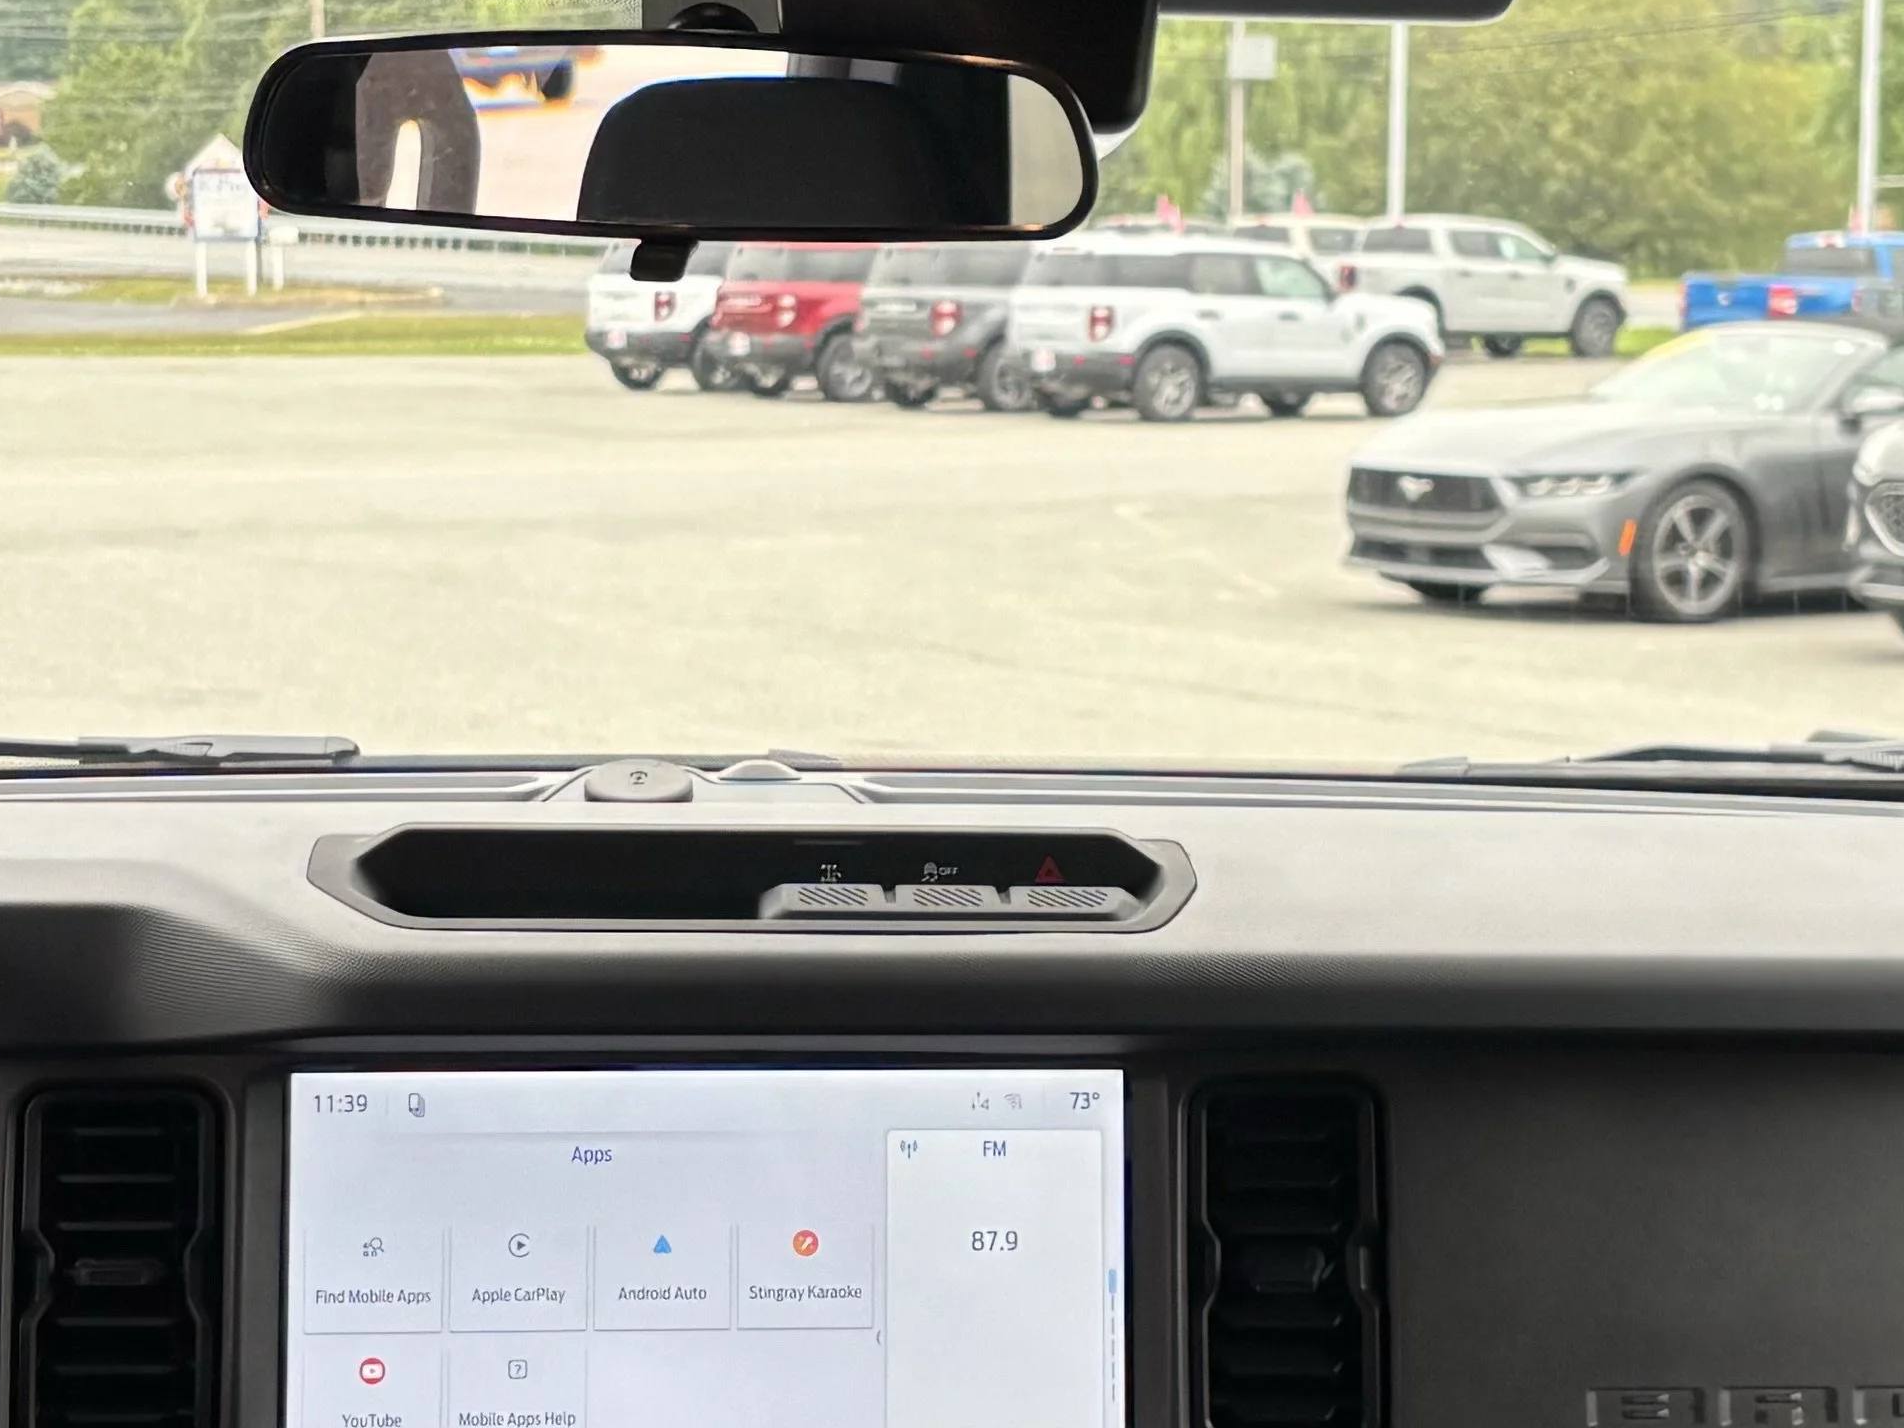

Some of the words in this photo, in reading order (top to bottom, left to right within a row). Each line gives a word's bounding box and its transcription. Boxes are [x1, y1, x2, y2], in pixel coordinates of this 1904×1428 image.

[313, 1094, 369, 1114] 11:39
[1069, 1091, 1101, 1111] 73°
[571, 1145, 613, 1165] Apps
[982, 1140, 1007, 1157] FM
[971, 1229, 1019, 1252] 87.9
[315, 1288, 345, 1305] Find
[348, 1288, 395, 1305] Mobile
[396, 1288, 432, 1306] Apps
[471, 1286, 512, 1305] Apple
[514, 1286, 566, 1305] CarPlay
[618, 1285, 671, 1301] Android
[674, 1285, 707, 1301] Auto
[748, 1284, 805, 1303] Stingray
[807, 1284, 863, 1300] Karaoke
[341, 1413, 402, 1428] YouTube
[458, 1412, 505, 1427] Mobile
[507, 1412, 542, 1428] Apps
[544, 1411, 577, 1428] Help
